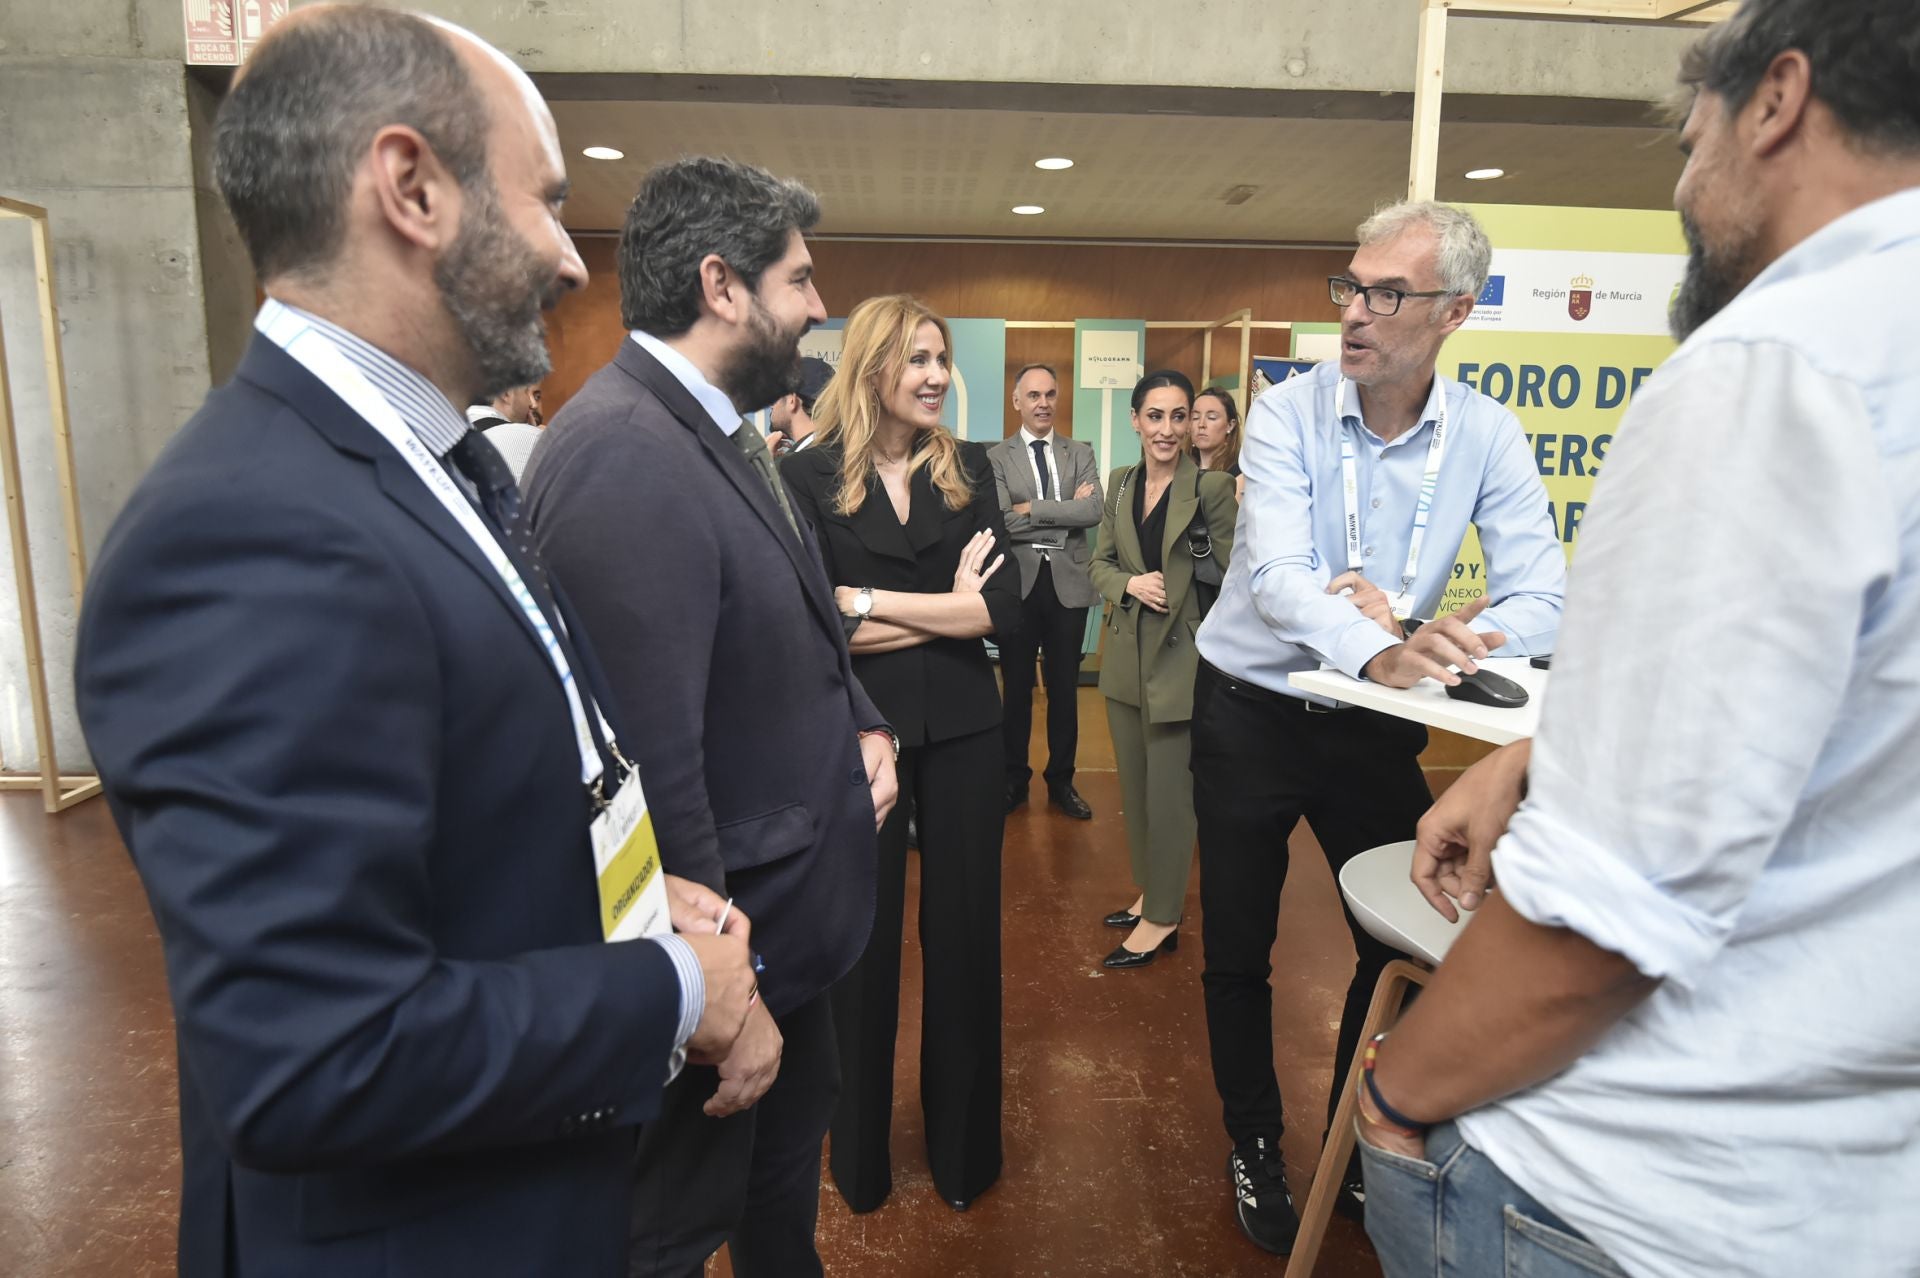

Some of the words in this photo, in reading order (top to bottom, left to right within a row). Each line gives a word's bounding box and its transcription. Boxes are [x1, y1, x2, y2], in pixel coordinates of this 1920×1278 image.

[194, 43, 218, 53] BOCA
[219, 43, 232, 53] DE
[192, 53, 235, 62] INCENDIO
[1532, 288, 1566, 299] Región
[1595, 290, 1607, 300] de
[1609, 290, 1642, 301] Murcia
[1457, 362, 1581, 409] FORO
[1525, 433, 1614, 478] ERS
[1468, 562, 1480, 580] Y
[1443, 588, 1483, 599] ANEXO
